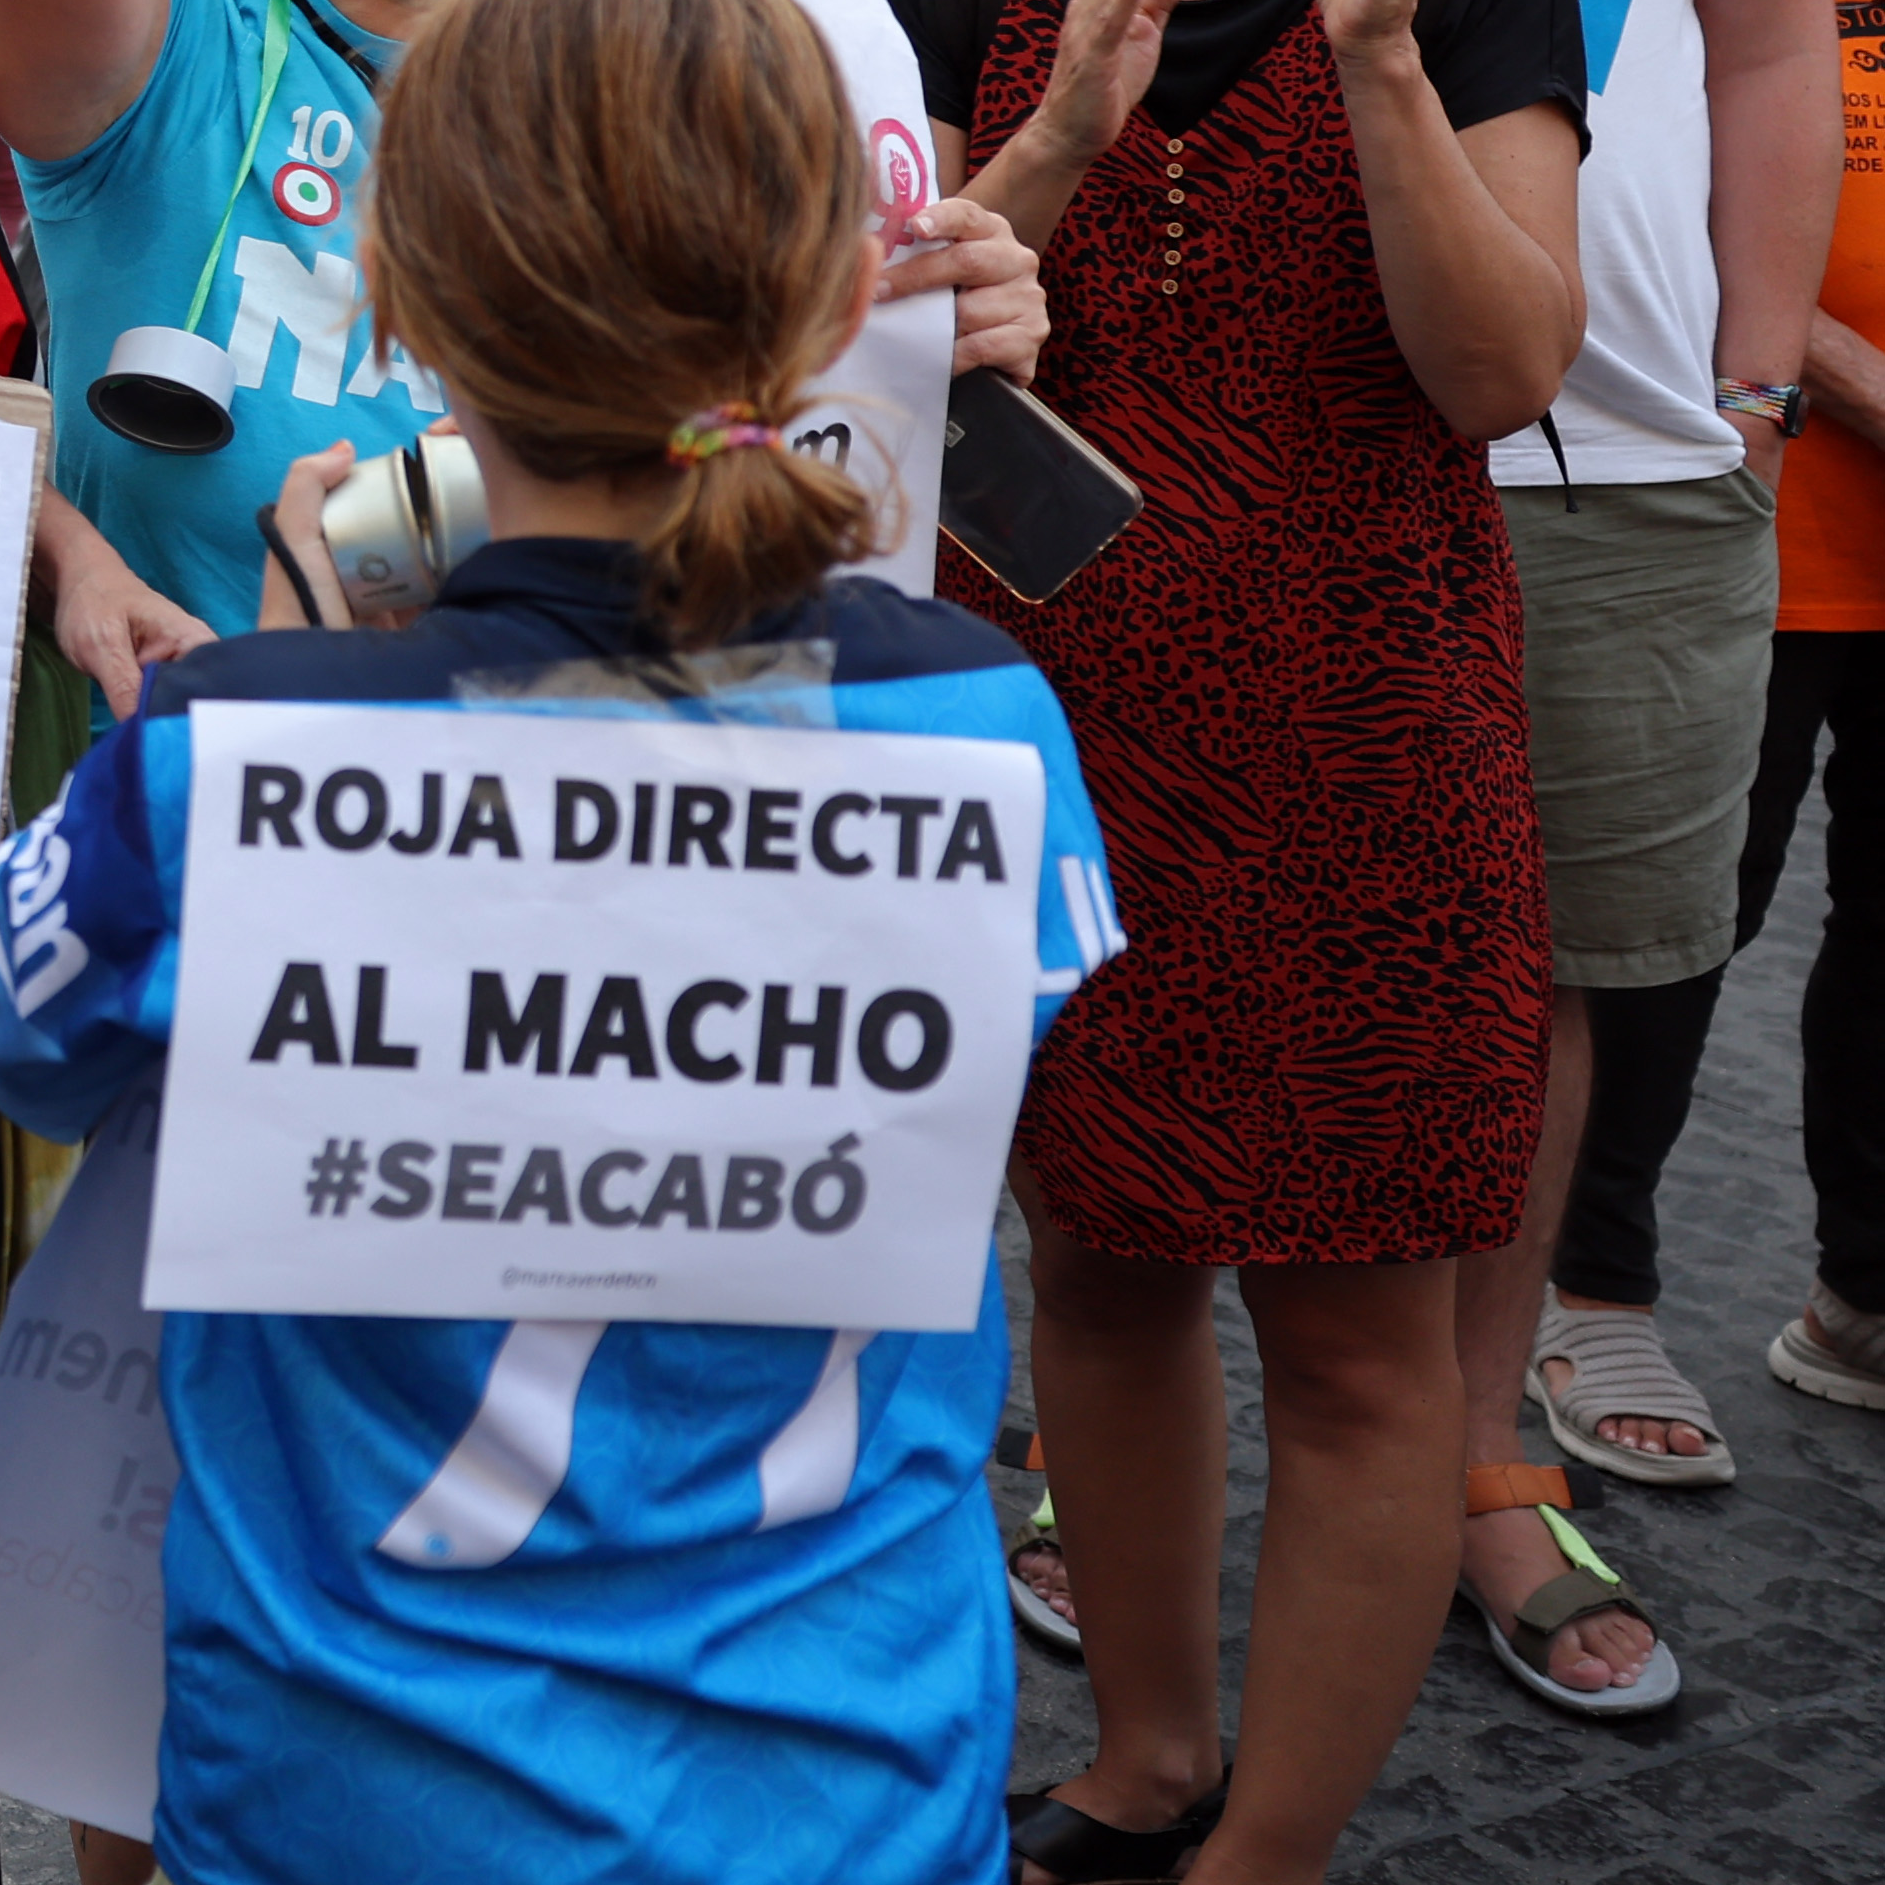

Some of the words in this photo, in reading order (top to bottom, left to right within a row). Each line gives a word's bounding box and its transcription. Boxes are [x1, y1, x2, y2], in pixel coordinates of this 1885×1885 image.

[287, 105, 354, 168] 10
[238, 764, 521, 860] ROJA
[553, 778, 1007, 883] DIRECTA
[249, 962, 420, 1070] AL
[463, 970, 954, 1093] MACHO
[305, 1132, 867, 1236] #SEACABÓ
